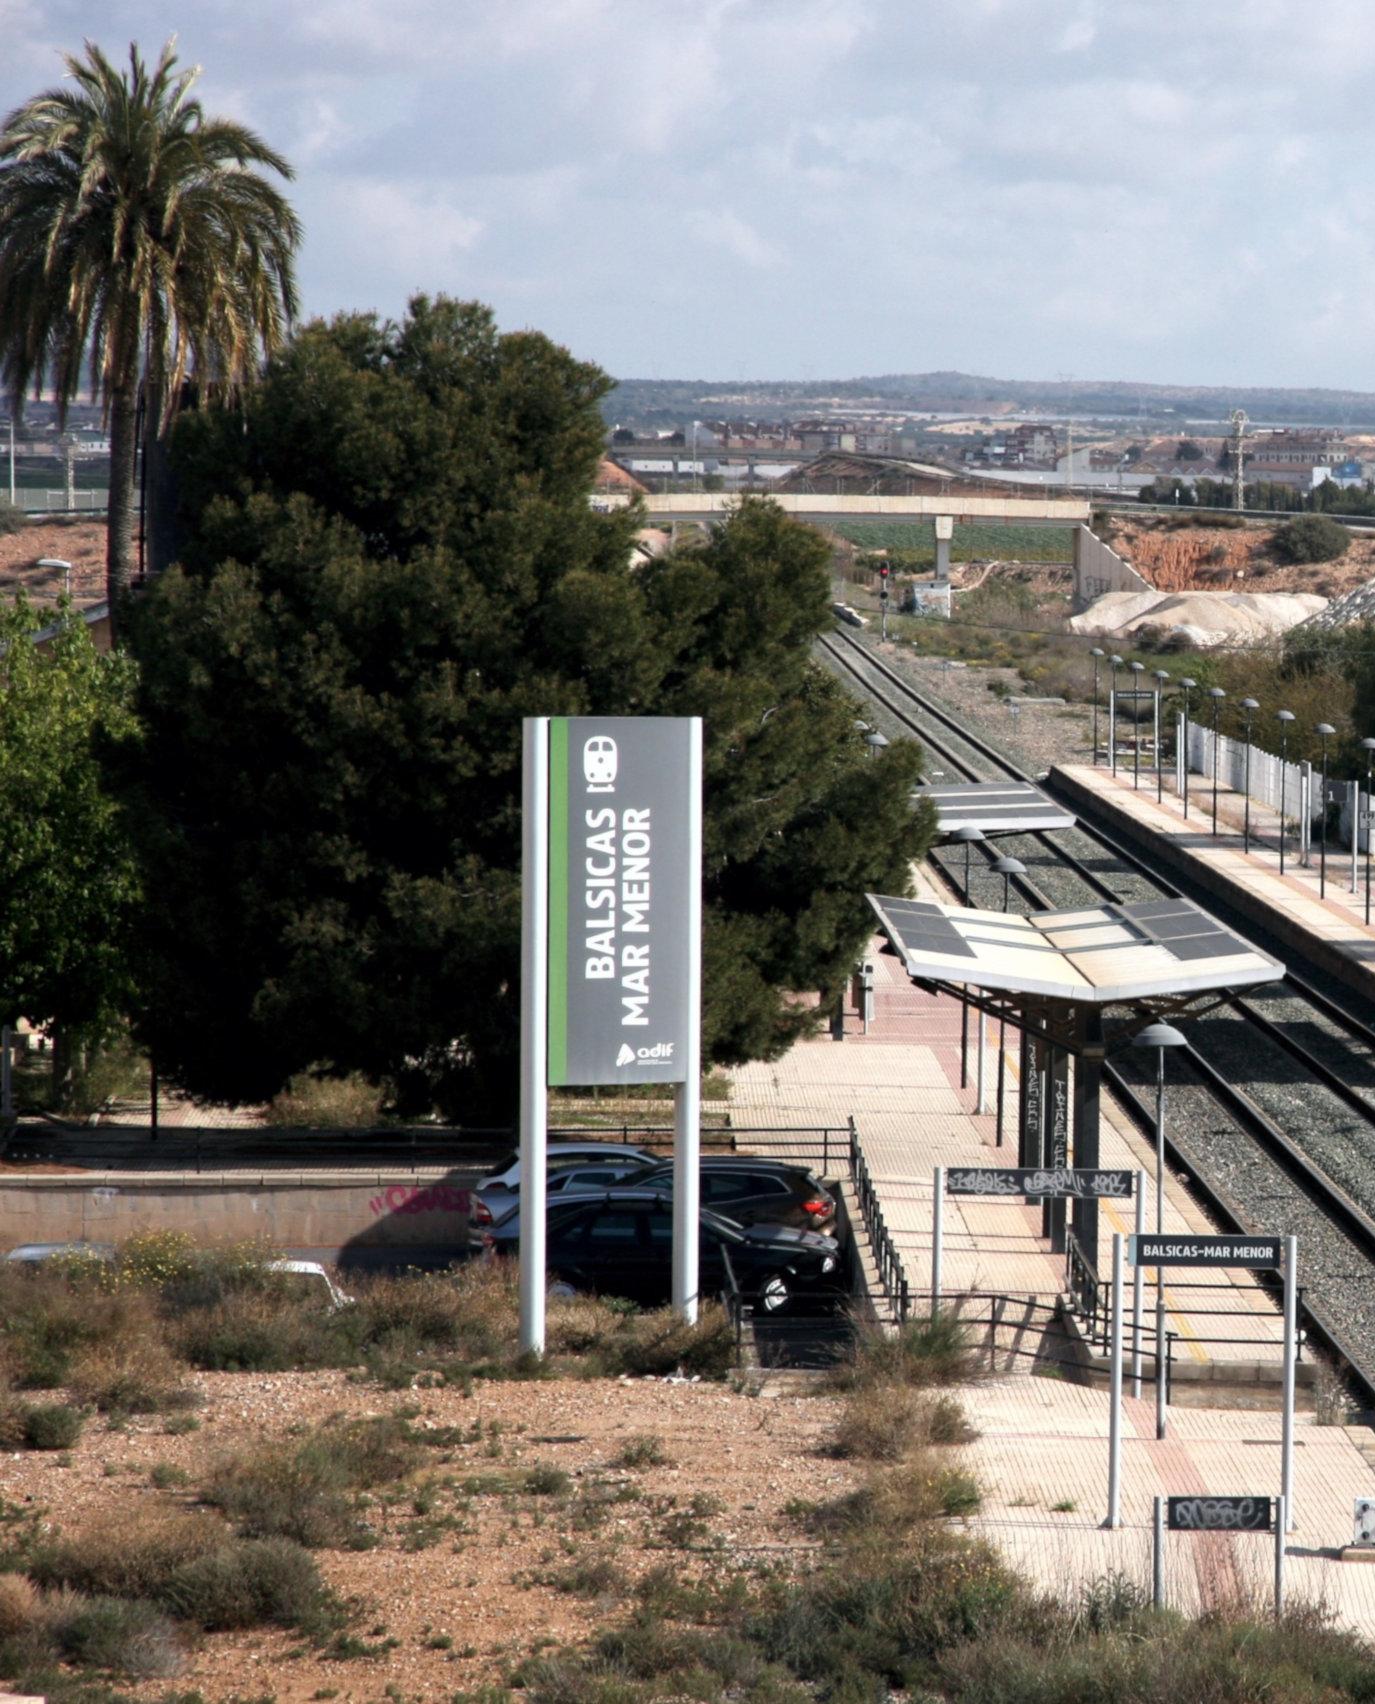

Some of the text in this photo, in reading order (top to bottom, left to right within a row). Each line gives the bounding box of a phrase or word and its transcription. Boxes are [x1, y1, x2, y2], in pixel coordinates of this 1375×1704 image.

[585, 807, 616, 979] BALSICAS
[621, 807, 651, 1026] MAR MENOR
[637, 1042, 675, 1058] adif
[1143, 1244, 1274, 1259] BALSICAS-MAR MENOR
